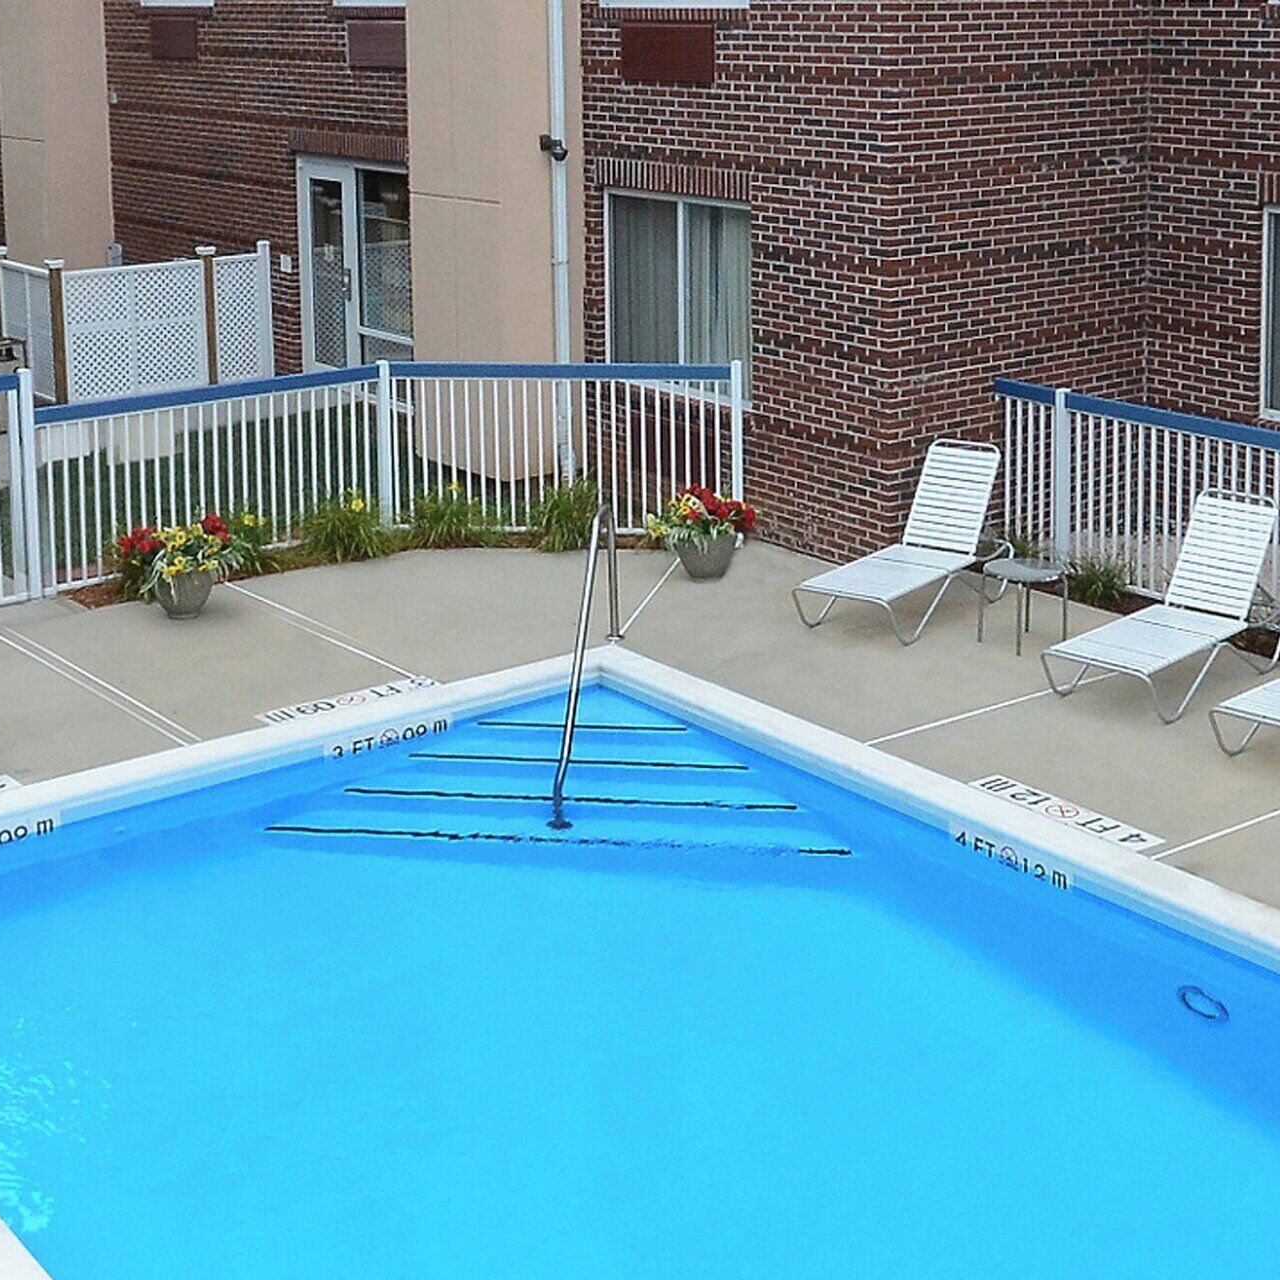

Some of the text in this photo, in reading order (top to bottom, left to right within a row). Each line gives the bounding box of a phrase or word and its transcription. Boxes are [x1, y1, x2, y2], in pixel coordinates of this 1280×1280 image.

[352, 737, 374, 755] FT
[37, 818, 54, 836] m
[1076, 818, 1120, 835] FT
[955, 831, 967, 847] 4
[973, 837, 997, 859] FT
[1052, 870, 1068, 890] m
